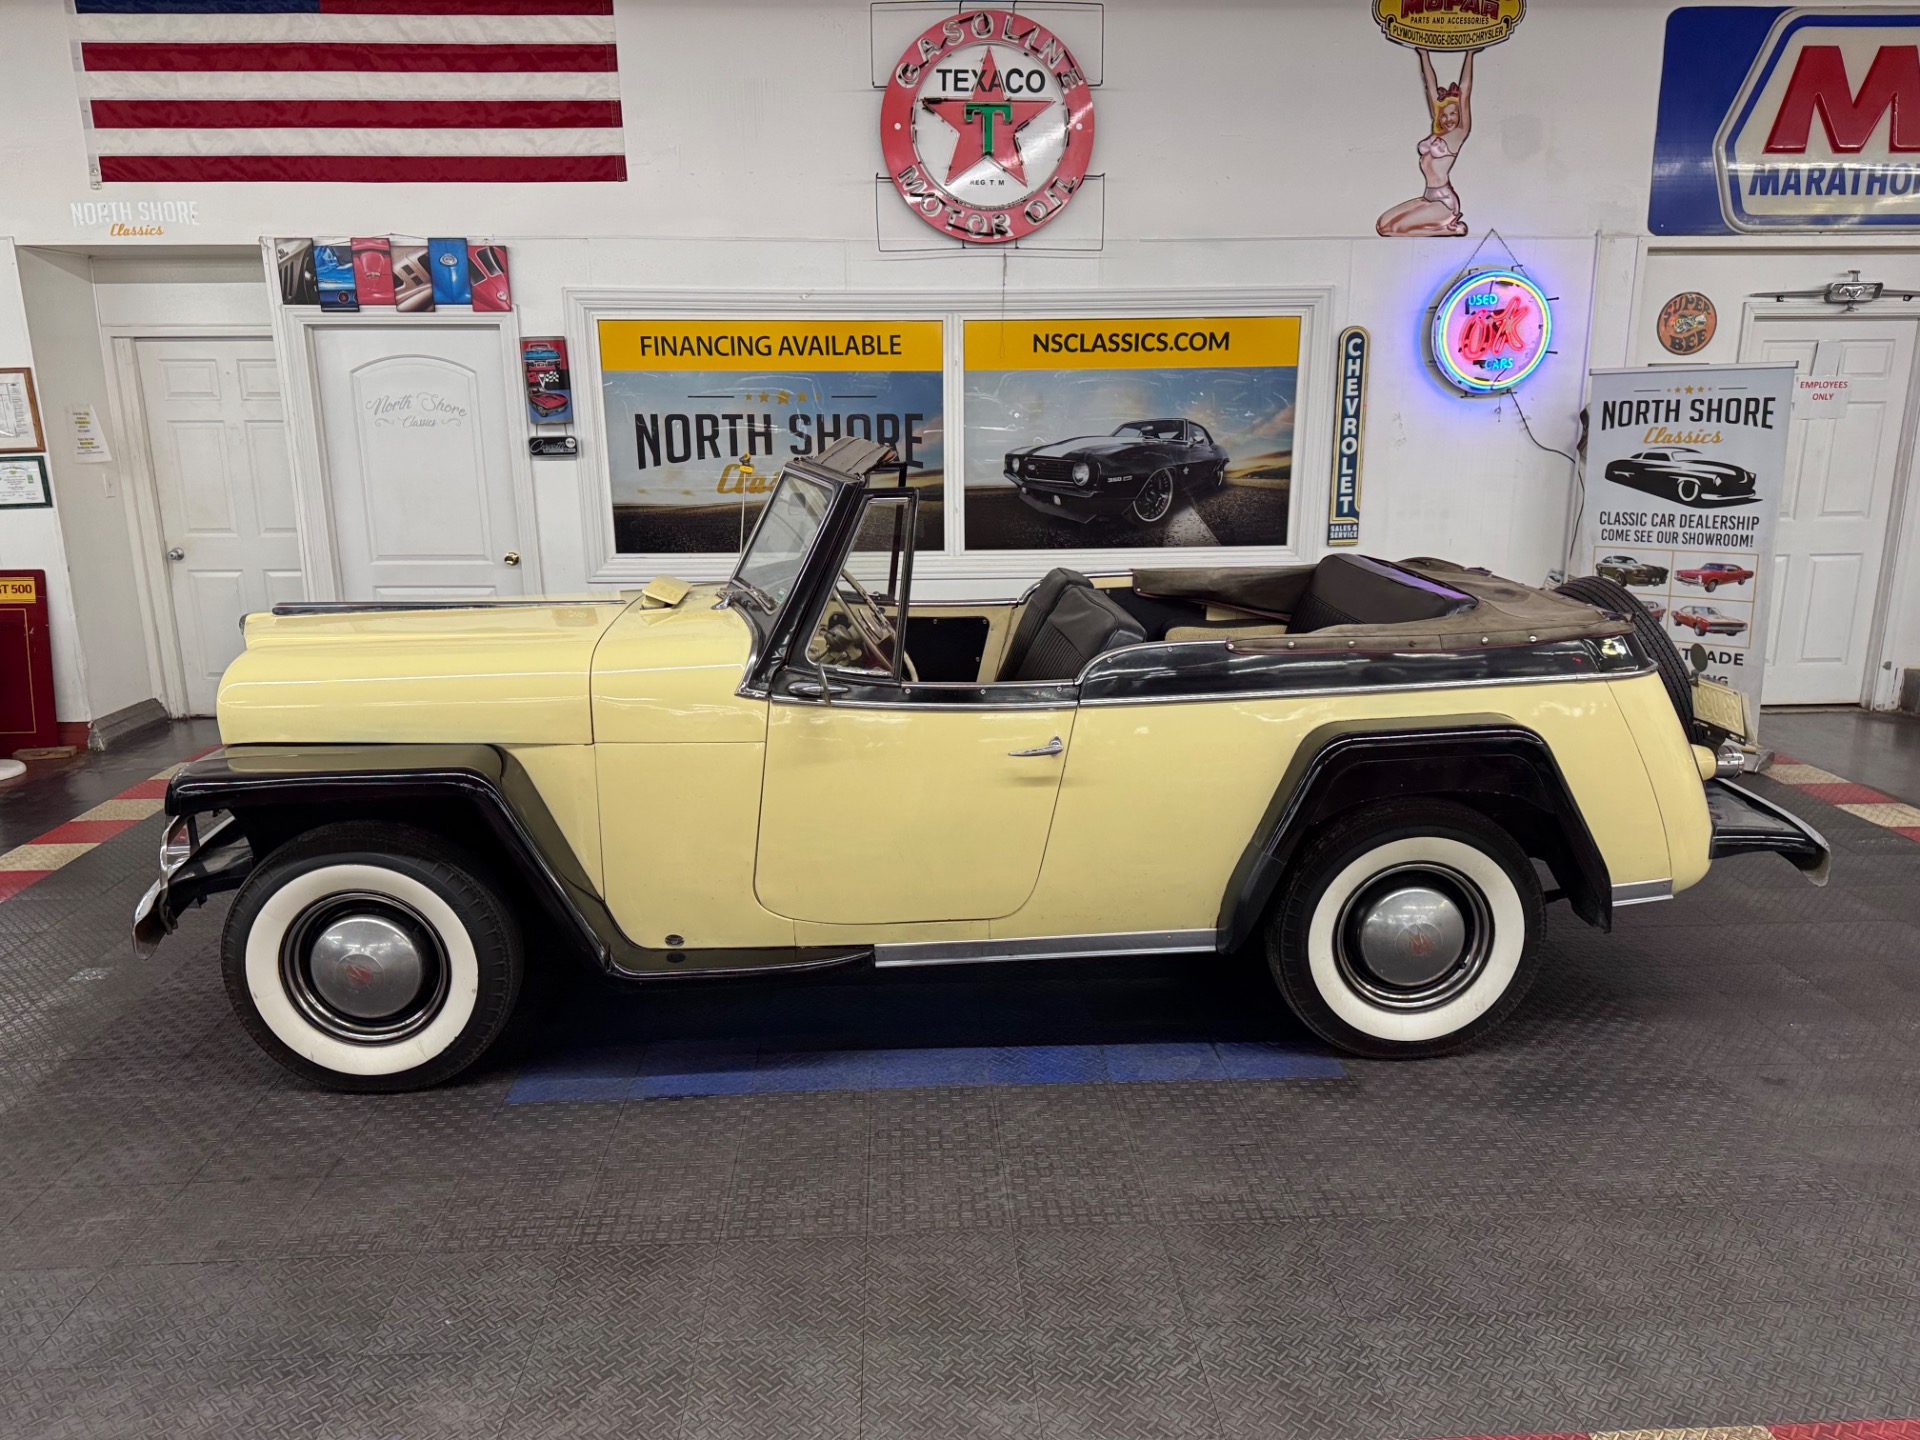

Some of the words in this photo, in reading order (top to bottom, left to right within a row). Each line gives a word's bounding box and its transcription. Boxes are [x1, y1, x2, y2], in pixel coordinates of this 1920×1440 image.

[1410, 16, 1430, 25] PARTS
[1432, 16, 1445, 25] AND
[1447, 16, 1490, 25] ACCESSORIES
[896, 11, 1084, 94] GASOLINE
[936, 68, 1046, 94] TEXACO
[963, 102, 1012, 156] T
[1748, 163, 1920, 196] MARATHO
[898, 165, 1014, 239] MOTOR
[1024, 176, 1078, 224] OIL
[70, 201, 132, 228] NORTH
[137, 200, 201, 226] SHORE
[110, 223, 165, 237] Classics
[1468, 293, 1498, 306] USED
[1662, 295, 1712, 324] SUPER
[640, 335, 772, 357] FINANCING
[778, 334, 902, 356] AVAILABLE
[1032, 331, 1230, 354] NSCLASSICS.COM
[1669, 328, 1708, 351] BEE
[1484, 357, 1513, 370] CARS
[1799, 380, 1849, 390] EMPLOYEES
[1812, 392, 1834, 401] ONLY
[365, 394, 414, 416] North
[416, 392, 468, 417] Shore
[1601, 399, 1681, 431] NORTH
[1689, 397, 1776, 430] SHORE
[398, 415, 437, 428] Classics
[1340, 337, 1363, 514] CHEVROLET
[634, 413, 773, 471] NORTH
[1642, 426, 1724, 444] Classics
[1599, 511, 1648, 527] CLASSIC
[1651, 513, 1676, 528] CAR
[1679, 514, 1760, 531] DEALERSHIP
[1330, 531, 1358, 539] SERVICE
[1601, 528, 1632, 542] COME
[1633, 530, 1653, 543] SEE
[1656, 531, 1679, 545] OUR
[1681, 532, 1754, 548] SHOWROOM!
[11, 584, 32, 594] 500
[1681, 648, 1745, 666] TADE
